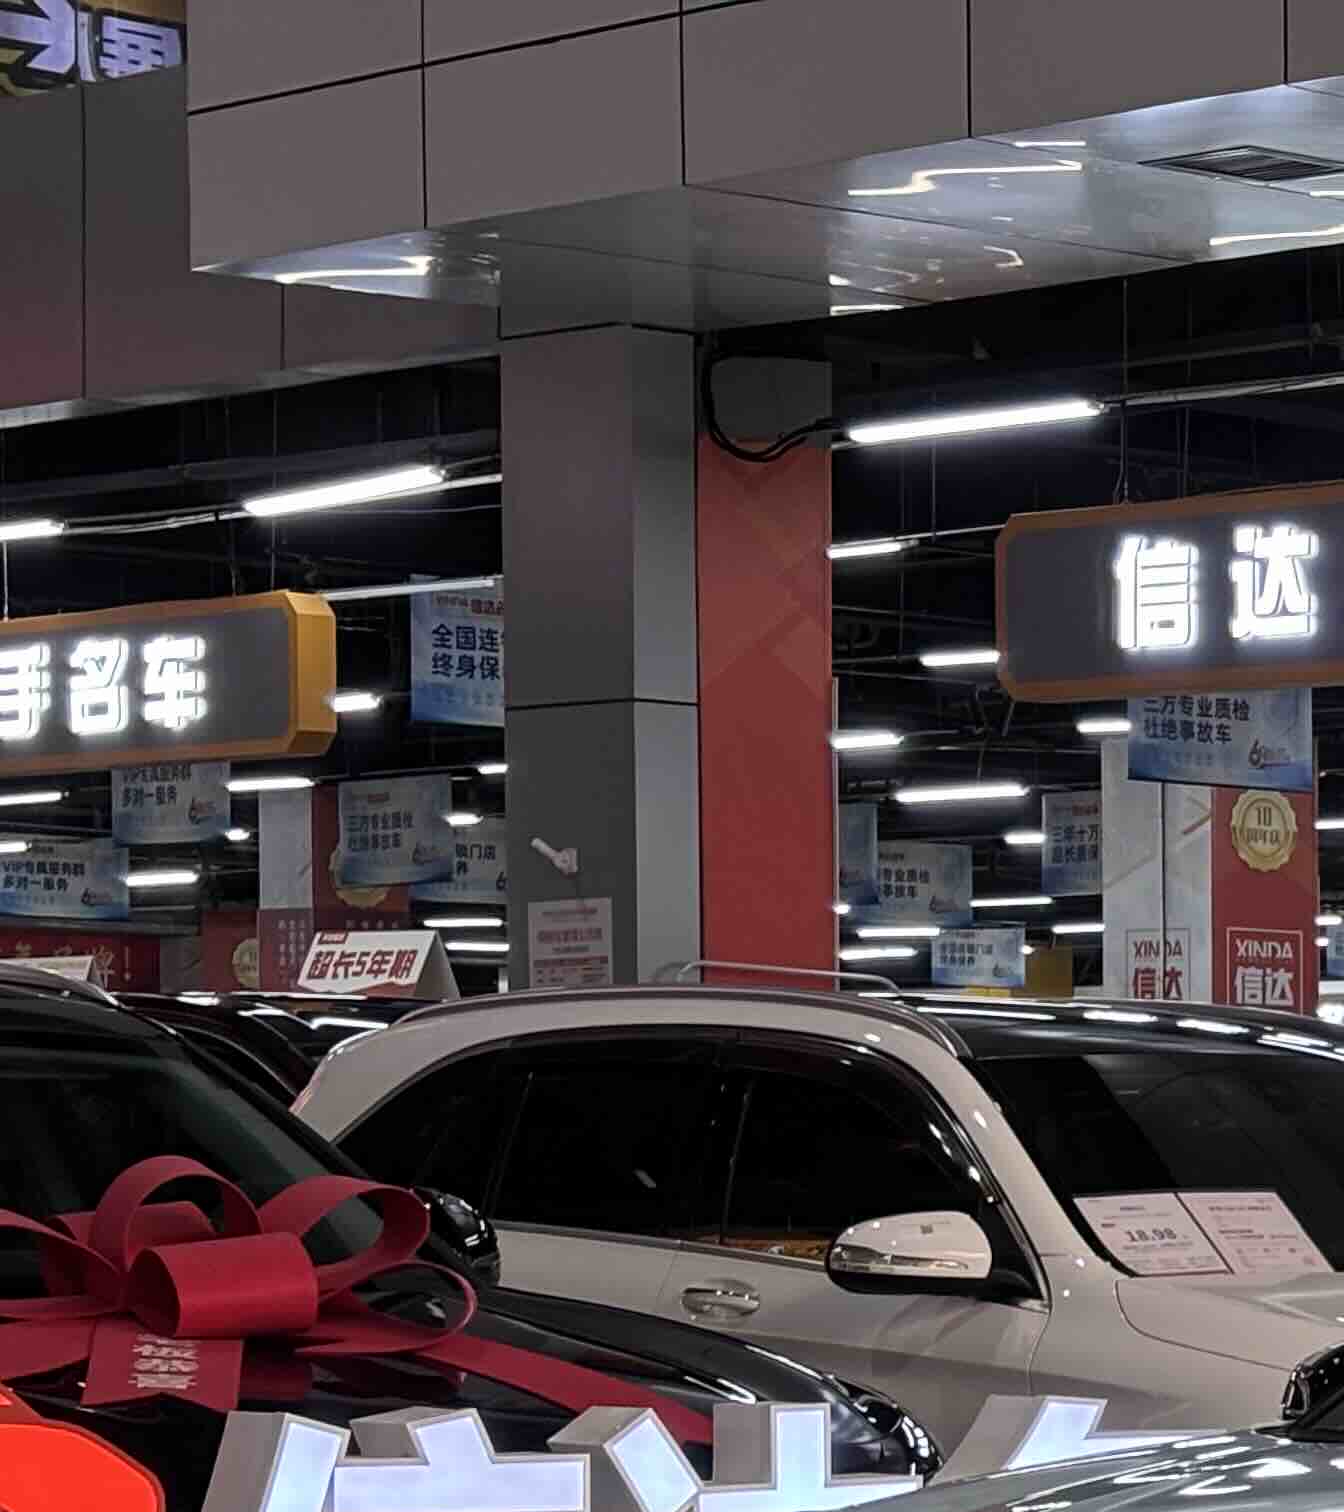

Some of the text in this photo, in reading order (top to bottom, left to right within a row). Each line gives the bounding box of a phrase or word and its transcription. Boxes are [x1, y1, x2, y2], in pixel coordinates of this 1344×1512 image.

[431, 623, 503, 652] 全国连
[1234, 937, 1294, 960] XINDA
[1233, 966, 1294, 1007] 信达
